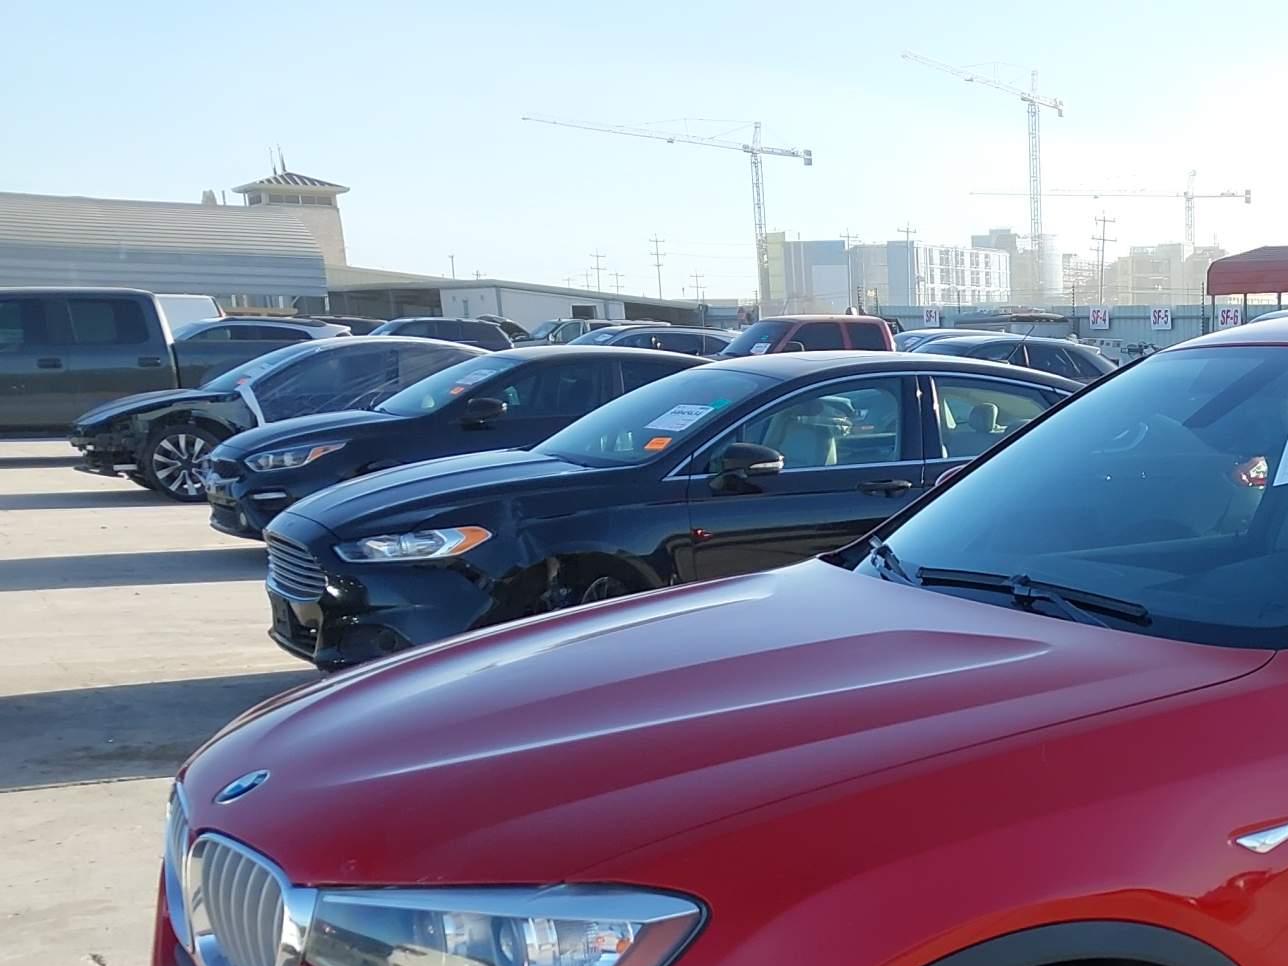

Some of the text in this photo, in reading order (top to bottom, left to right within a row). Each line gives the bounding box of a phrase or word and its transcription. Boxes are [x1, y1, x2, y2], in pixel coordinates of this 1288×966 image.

[1091, 309, 1107, 325] SF-4
[1152, 309, 1169, 325] SF-5
[1220, 309, 1239, 326] SF-6
